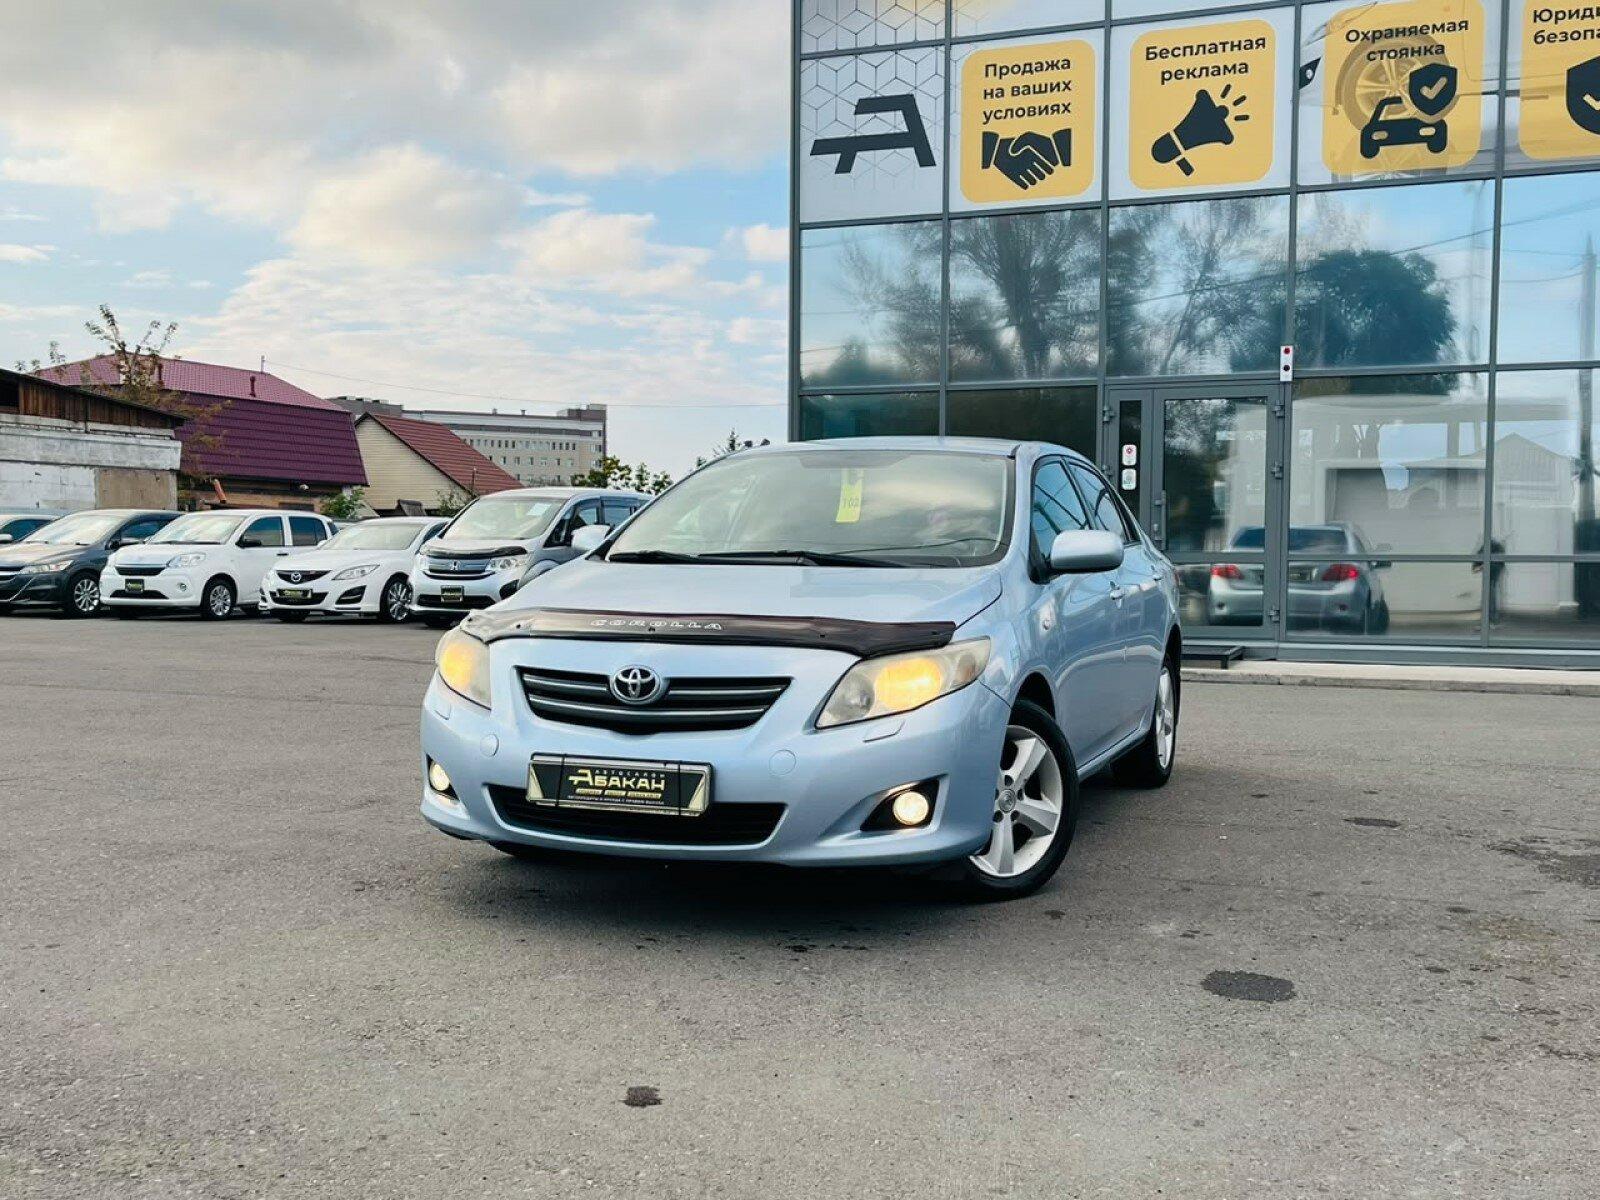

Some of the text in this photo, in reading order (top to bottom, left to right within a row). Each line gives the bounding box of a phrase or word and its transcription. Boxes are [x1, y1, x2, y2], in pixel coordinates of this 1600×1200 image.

[1345, 20, 1469, 43] Охраняемая
[1145, 36, 1267, 62] Бесплатная
[1366, 43, 1445, 62] стоянка
[984, 56, 1072, 80] Продажа
[1160, 60, 1249, 85] реклама
[983, 79, 1072, 100] на ваших
[982, 101, 1072, 125] условиях
[590, 619, 722, 630] COROLLA
